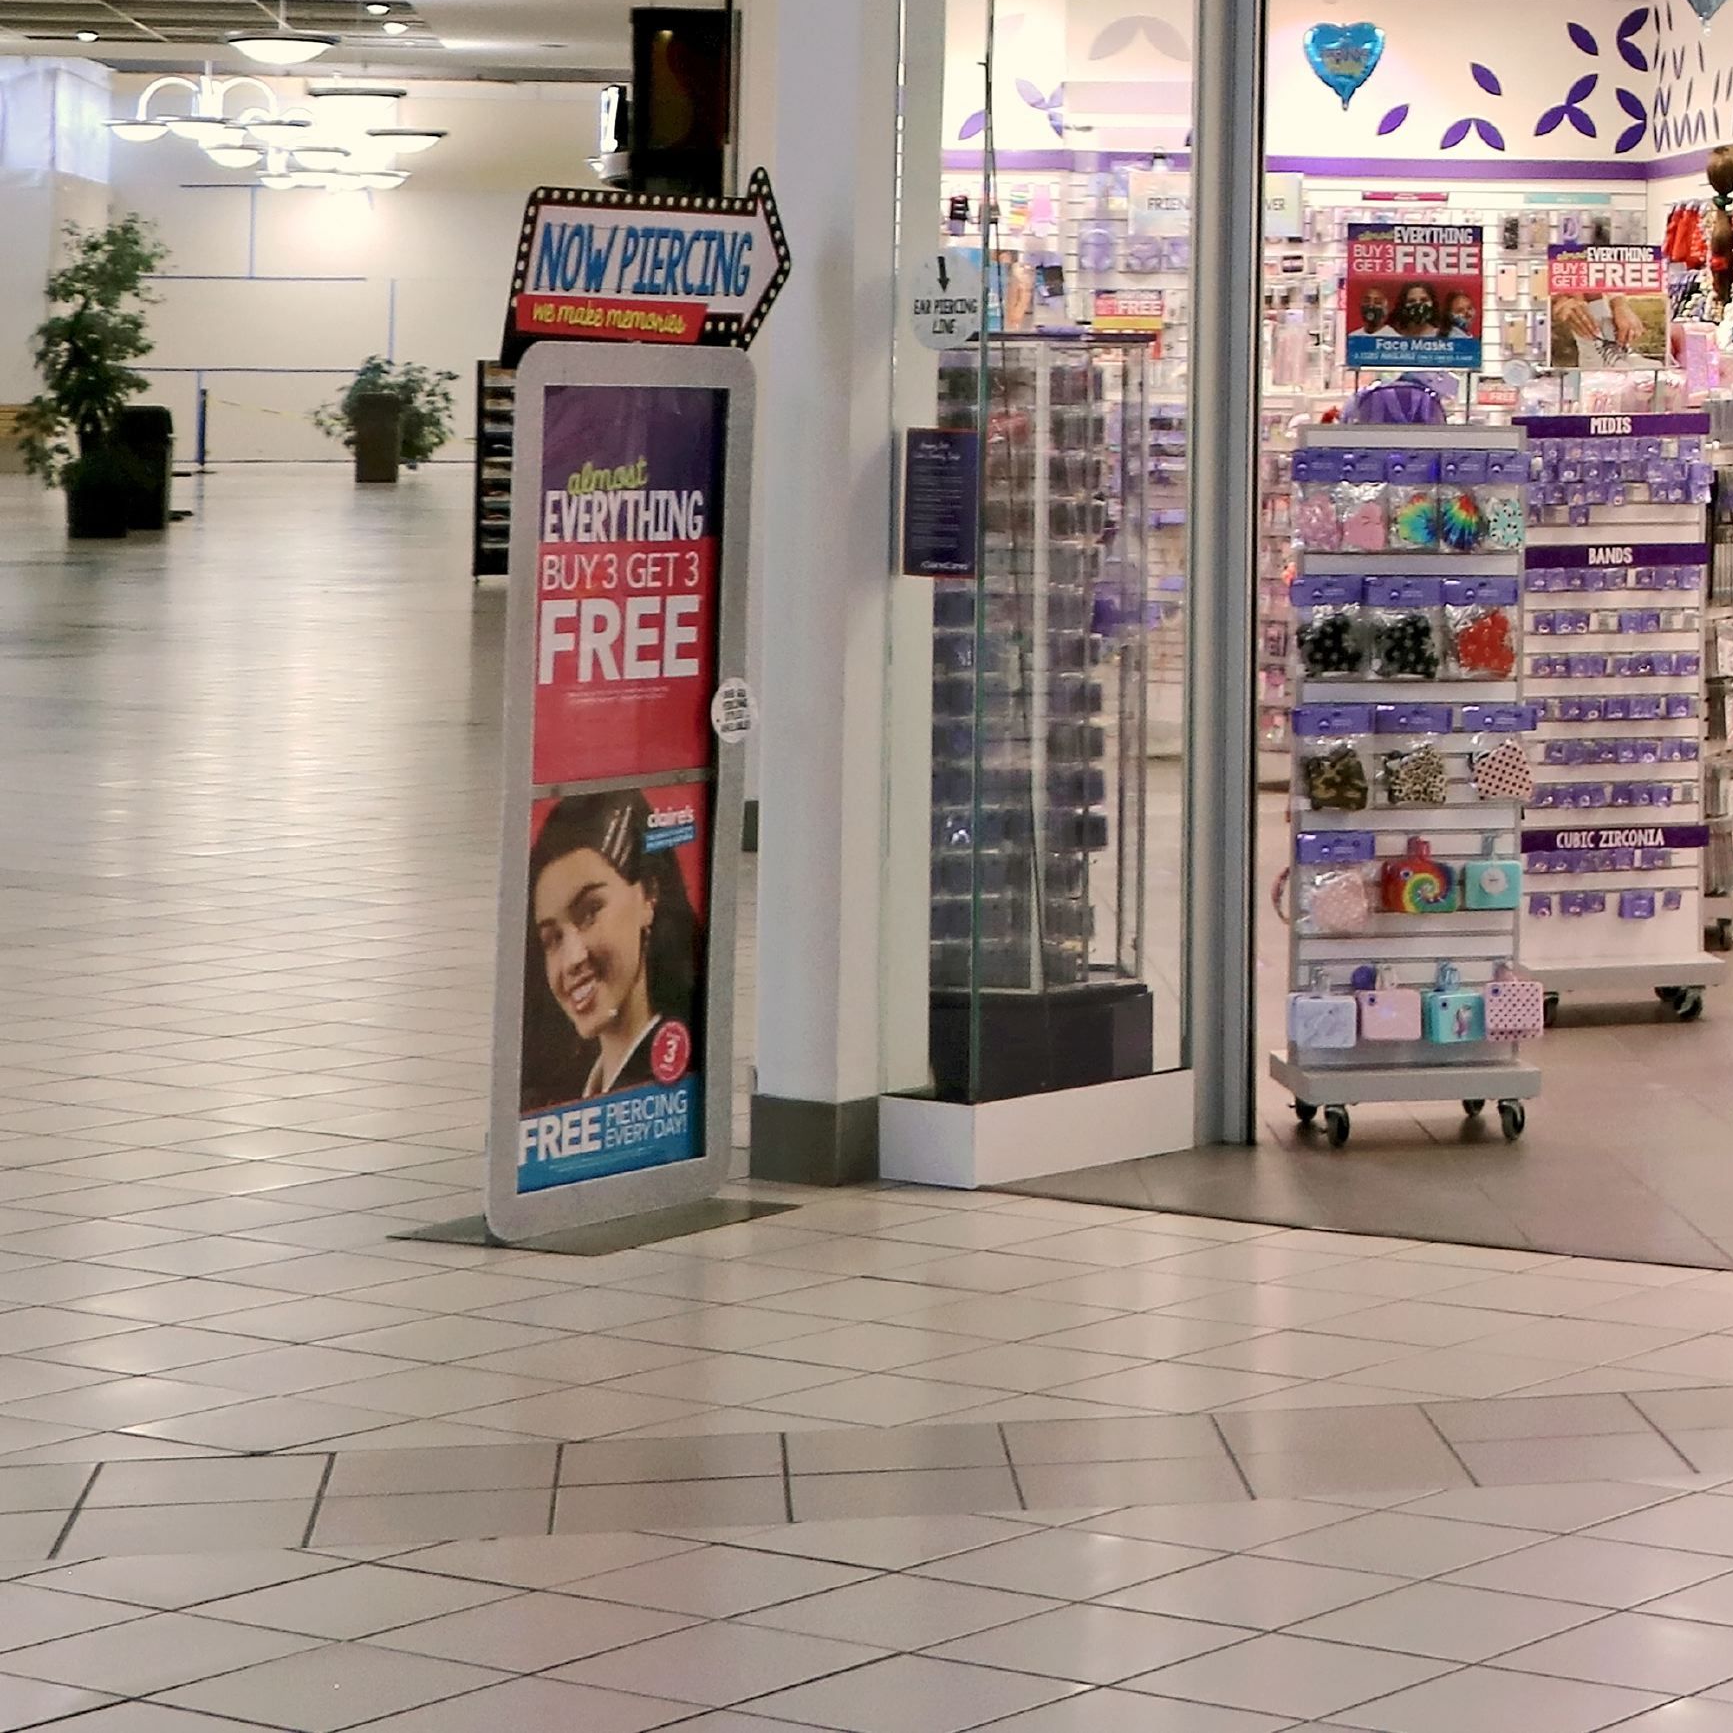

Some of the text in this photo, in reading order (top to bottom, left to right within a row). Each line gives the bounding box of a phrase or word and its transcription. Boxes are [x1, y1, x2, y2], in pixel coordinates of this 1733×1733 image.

[1394, 226, 1473, 244] EVERYTHING
[534, 223, 753, 297] NOW PIERCING
[1353, 244, 1395, 258] BUY 3
[1394, 245, 1480, 275] FREE
[1587, 247, 1654, 262] EVERYTHING
[1353, 259, 1395, 273] GET 3
[1552, 262, 1588, 275] BUY 3
[1588, 263, 1660, 288] FREE
[1552, 275, 1588, 287] GET 3
[913, 297, 978, 315] EAR PIERCING
[1118, 300, 1162, 316] FREE
[532, 300, 686, 335] we make memories
[932, 317, 955, 335] LINE
[1375, 338, 1454, 352] Face Masks
[1590, 416, 1632, 435] MIDIS
[567, 456, 648, 495] almost
[544, 489, 703, 543] EVERYTHING
[1589, 547, 1633, 564] BANDS
[542, 550, 699, 591] BUY 3 GET 3
[538, 594, 702, 685] FREE
[1556, 828, 1665, 848] CUBIC ZIRCONIA
[664, 1040, 677, 1064] 3
[518, 1089, 688, 1167] FREE PIERCING
[605, 1116, 689, 1148] EVERY DAY!
